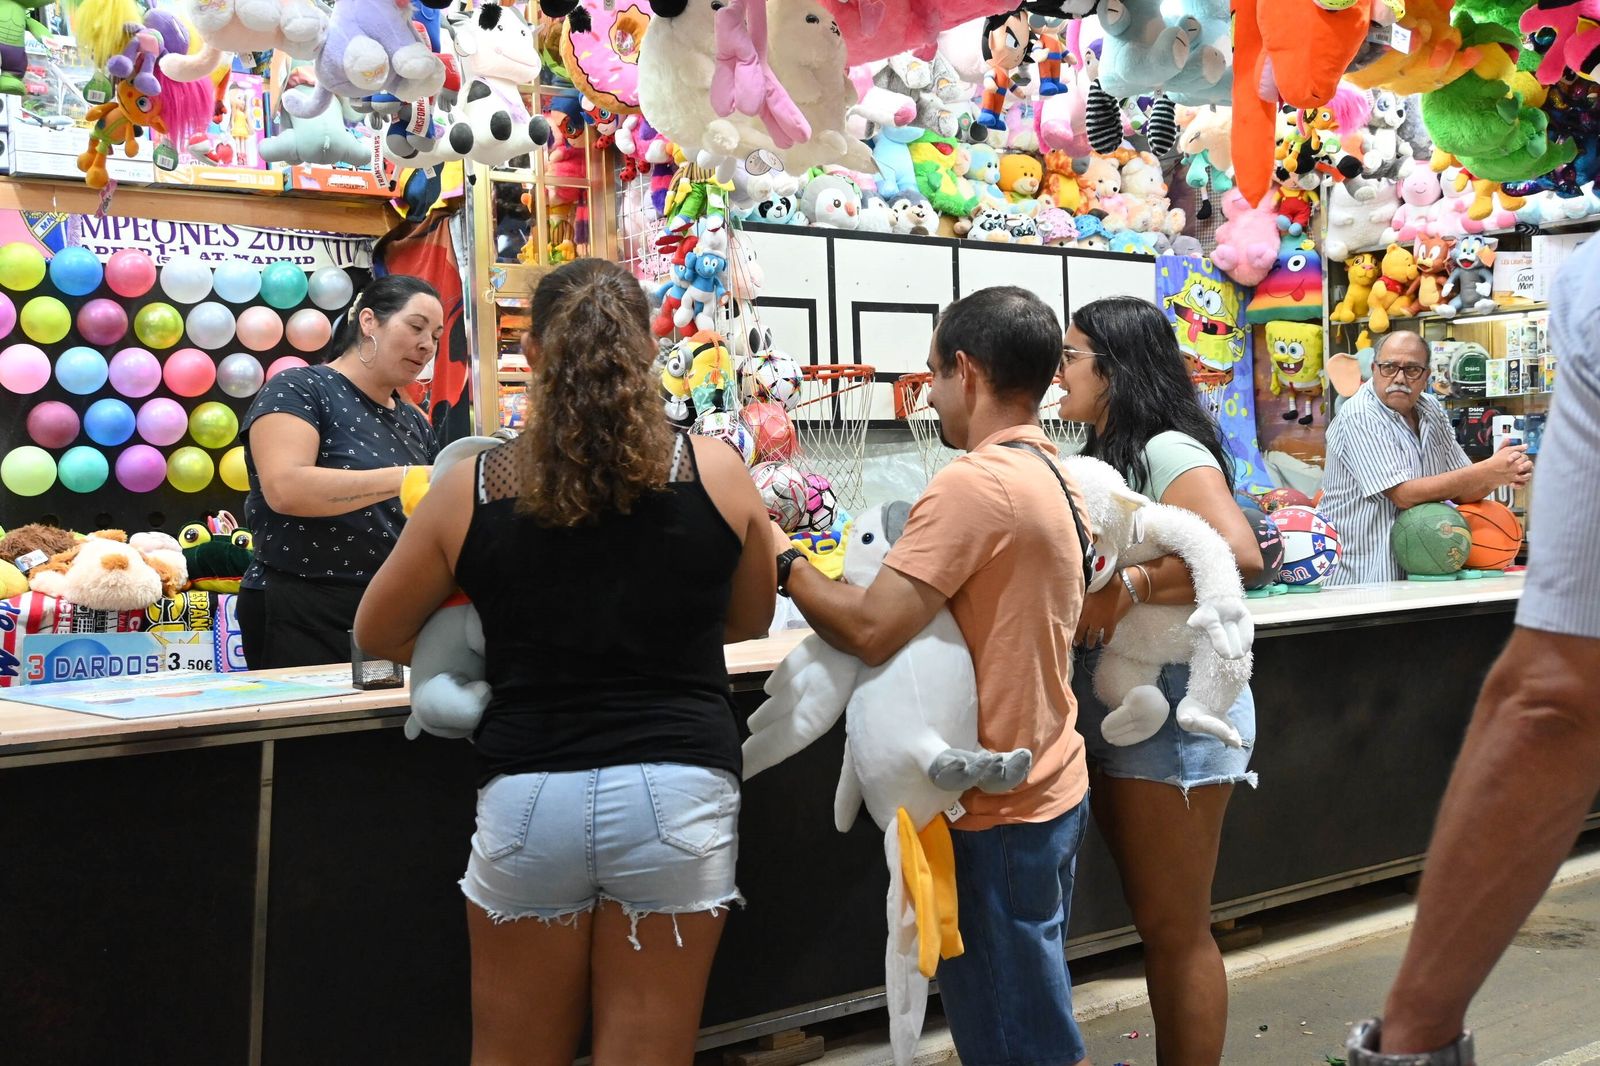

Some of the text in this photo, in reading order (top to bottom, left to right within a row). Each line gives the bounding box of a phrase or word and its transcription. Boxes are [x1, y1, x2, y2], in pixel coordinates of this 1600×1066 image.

[374, 135, 386, 187] TRANSFORMERS
[28, 655, 159, 680] 3 DARDOS
